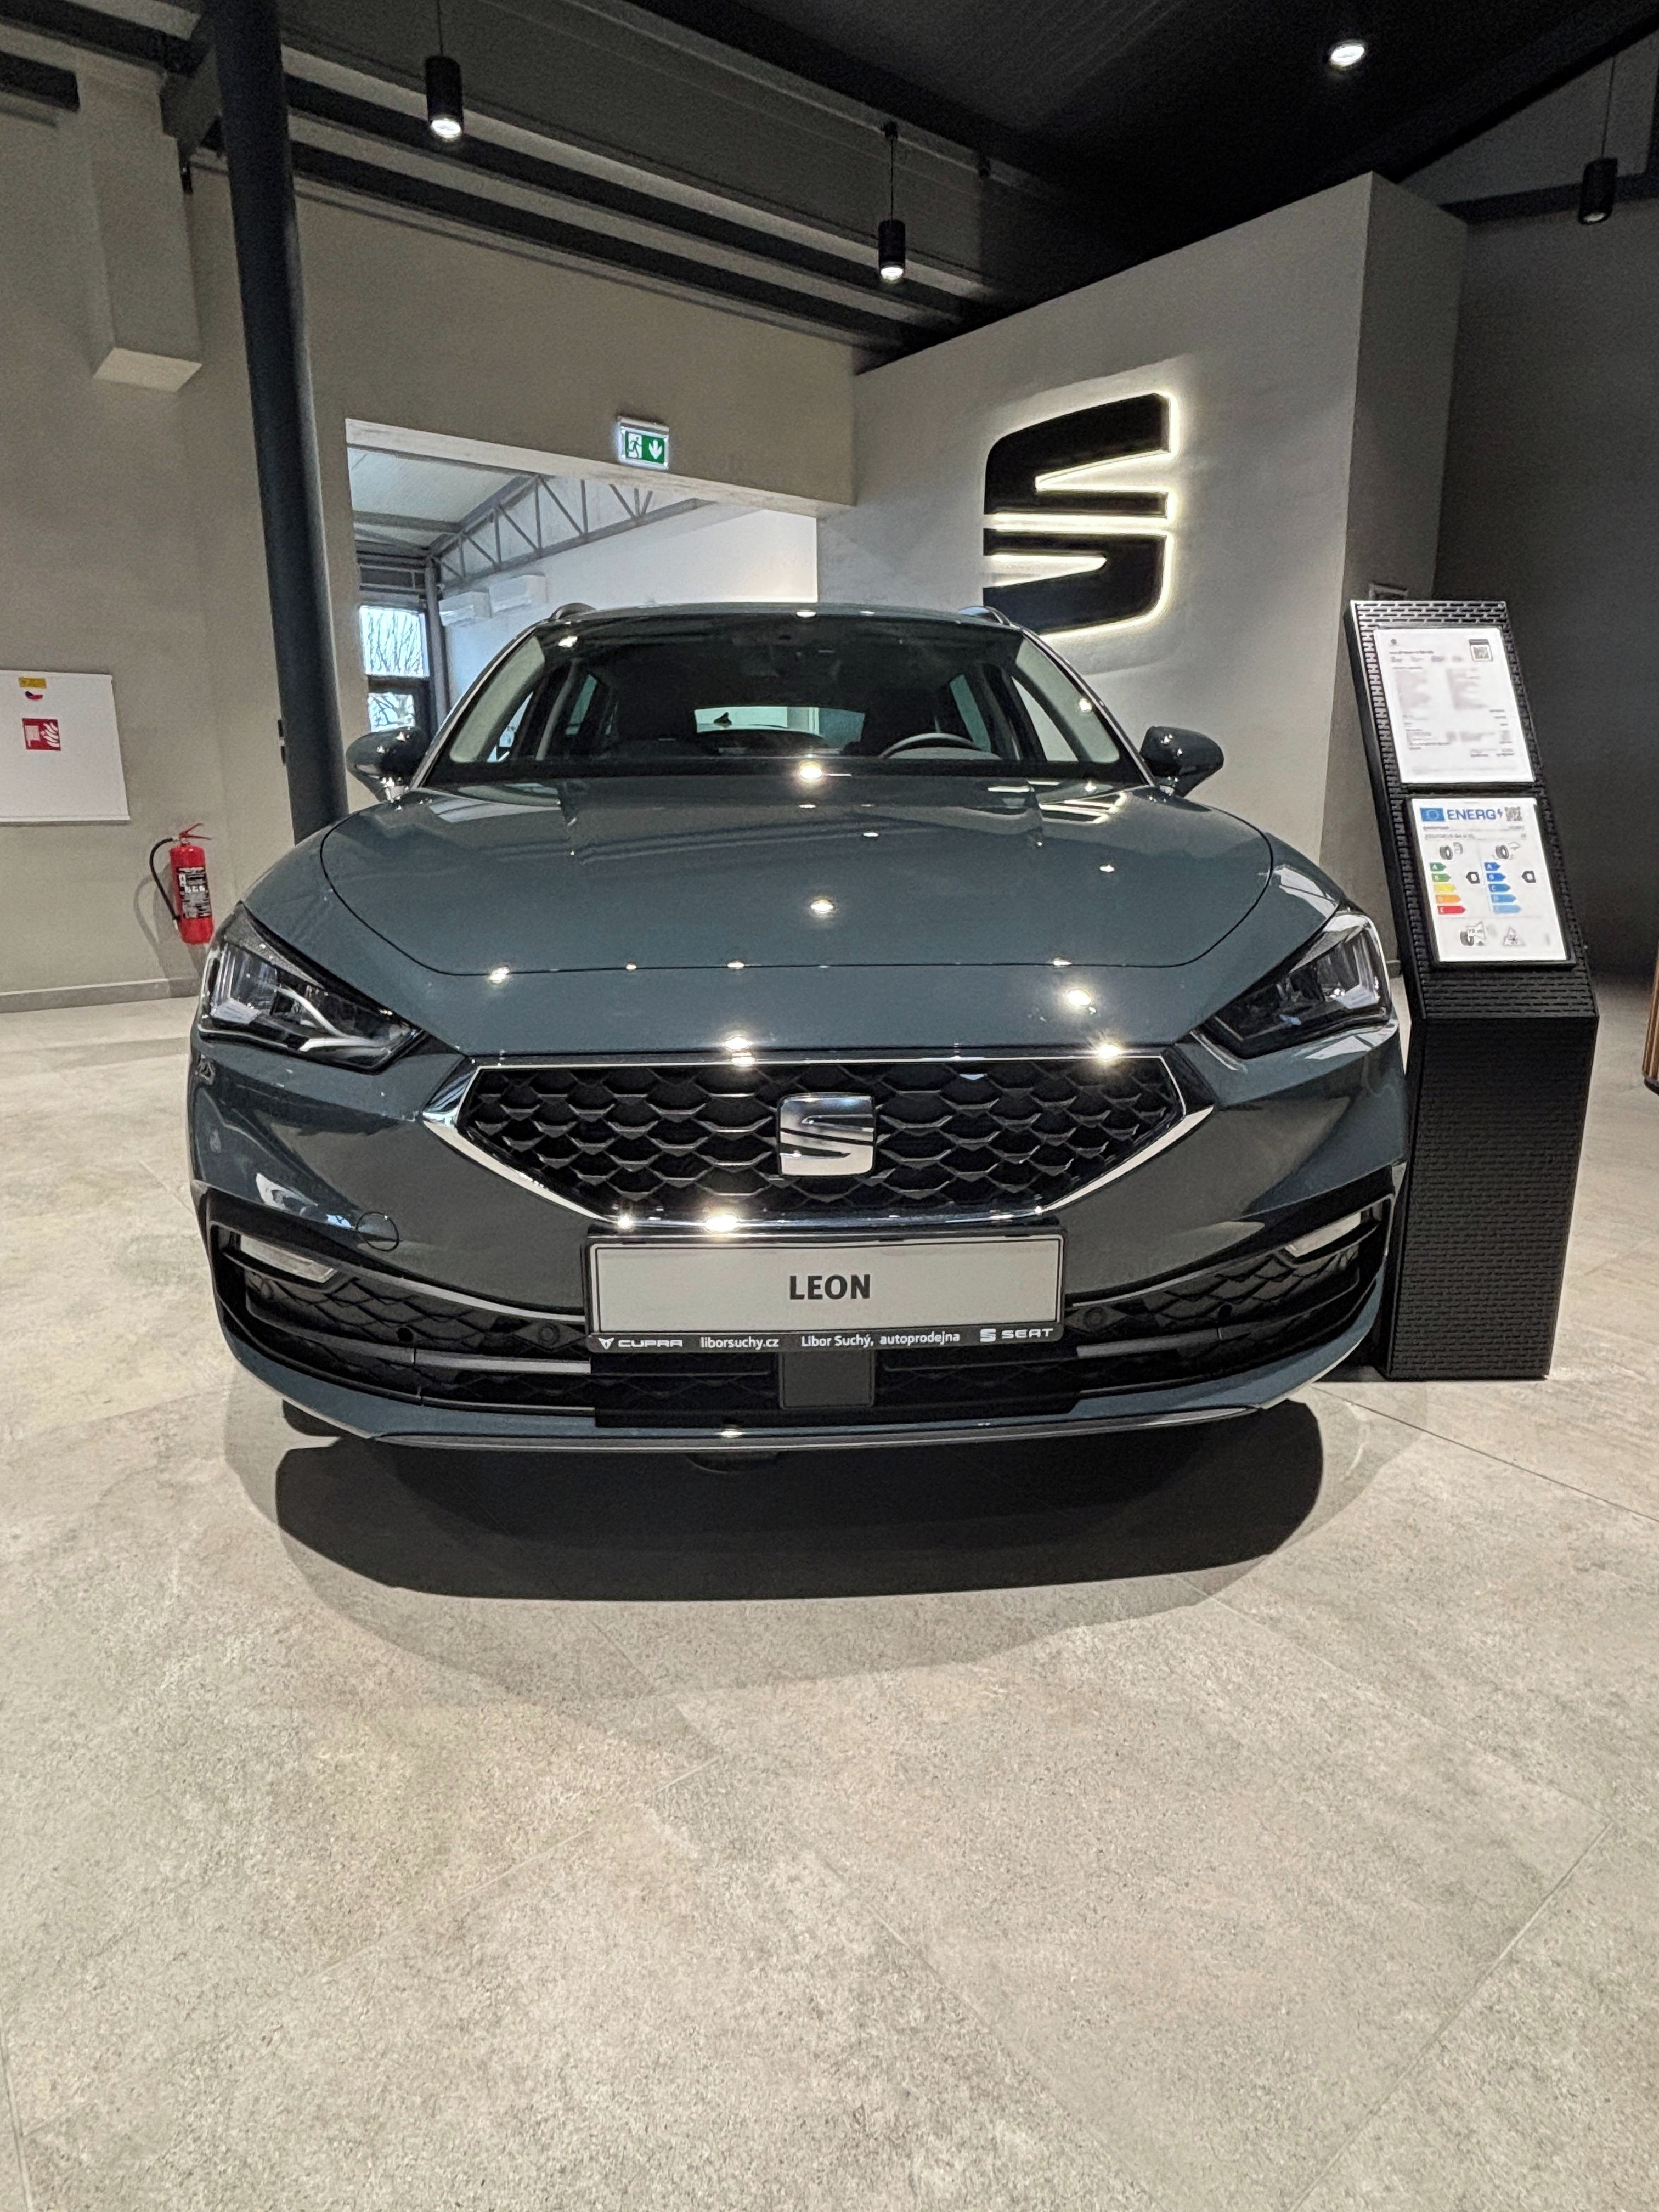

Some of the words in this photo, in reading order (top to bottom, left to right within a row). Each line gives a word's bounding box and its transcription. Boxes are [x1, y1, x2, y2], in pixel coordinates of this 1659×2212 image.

[1447, 809, 1496, 820] ENERG
[790, 1274, 870, 1300] LEON
[801, 1335, 832, 1347] Libor
[834, 1334, 874, 1348] Suchý,
[879, 1331, 960, 1346] autoprodejna
[1002, 1328, 1053, 1339] SEAT
[701, 1336, 779, 1350] liborsuchy.cz
